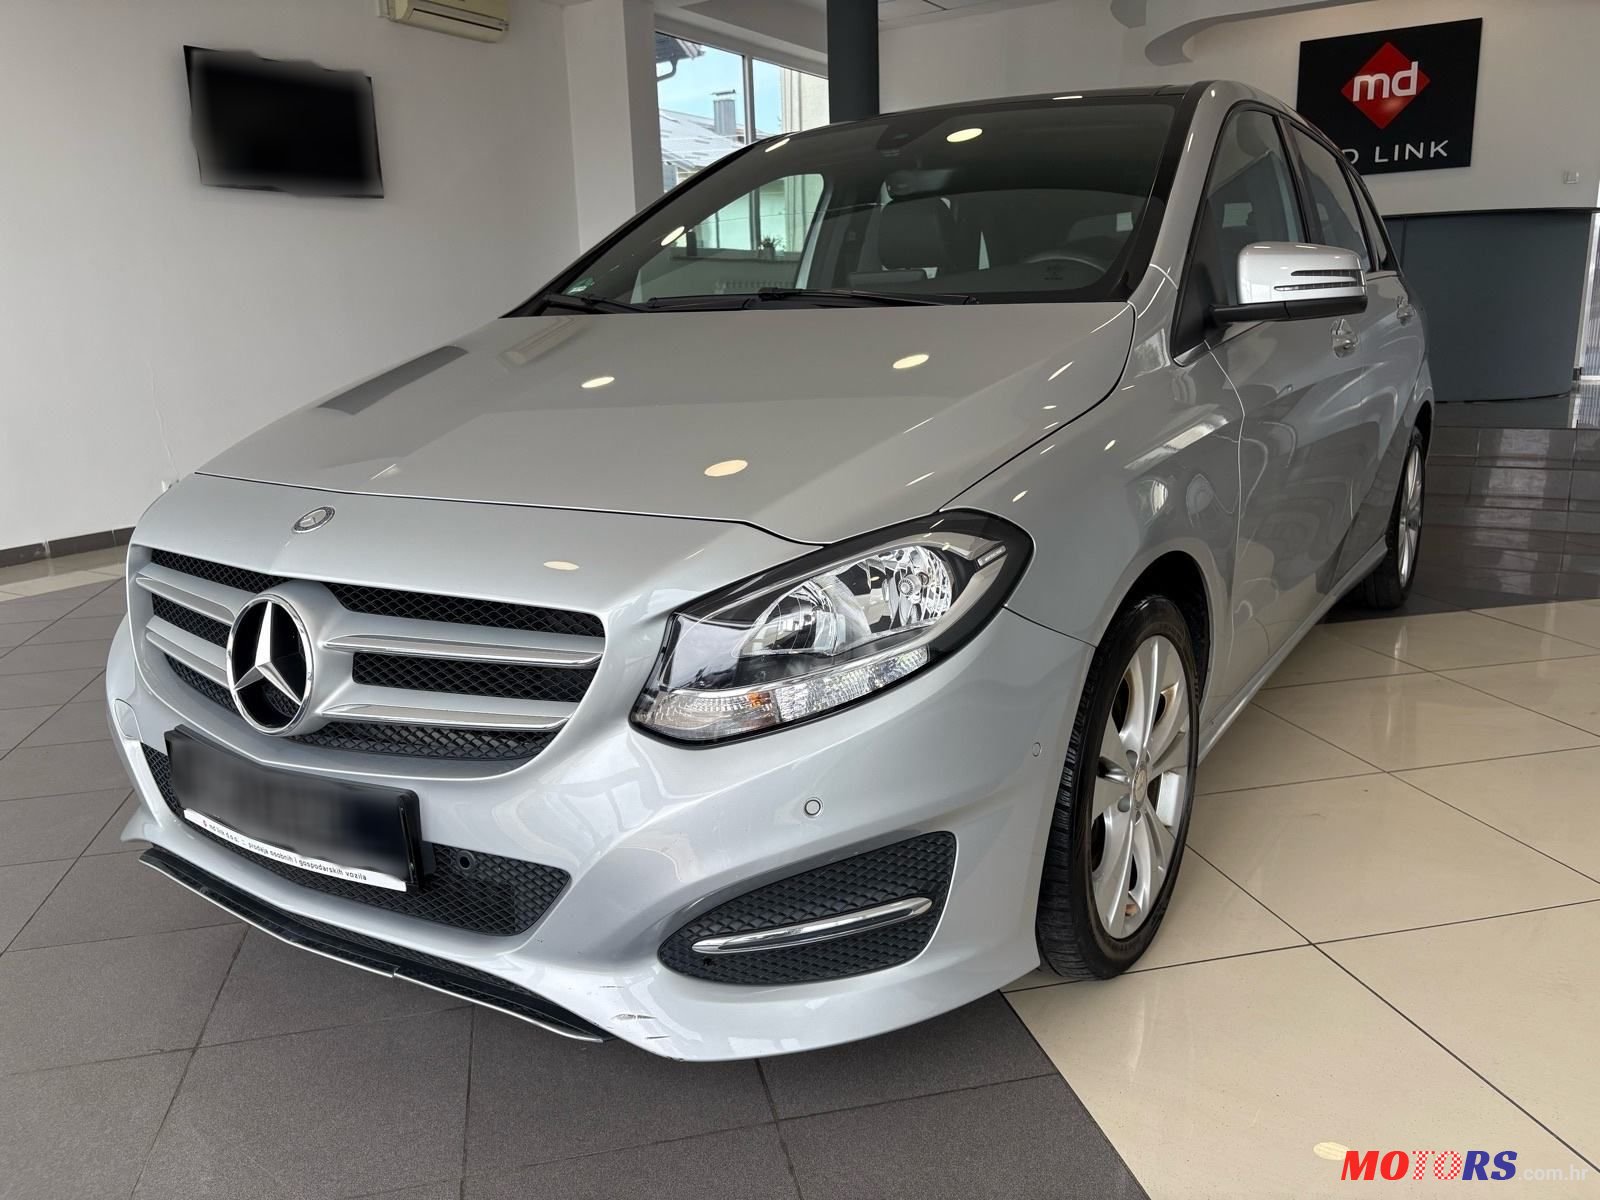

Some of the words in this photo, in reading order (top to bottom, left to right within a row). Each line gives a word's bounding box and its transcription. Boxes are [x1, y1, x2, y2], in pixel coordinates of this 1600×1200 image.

[1341, 148, 1360, 165] D
[1374, 139, 1449, 163] LINK
[270, 850, 294, 863] osobnih
[299, 859, 344, 875] gospodarskih
[345, 871, 367, 881] vozila
